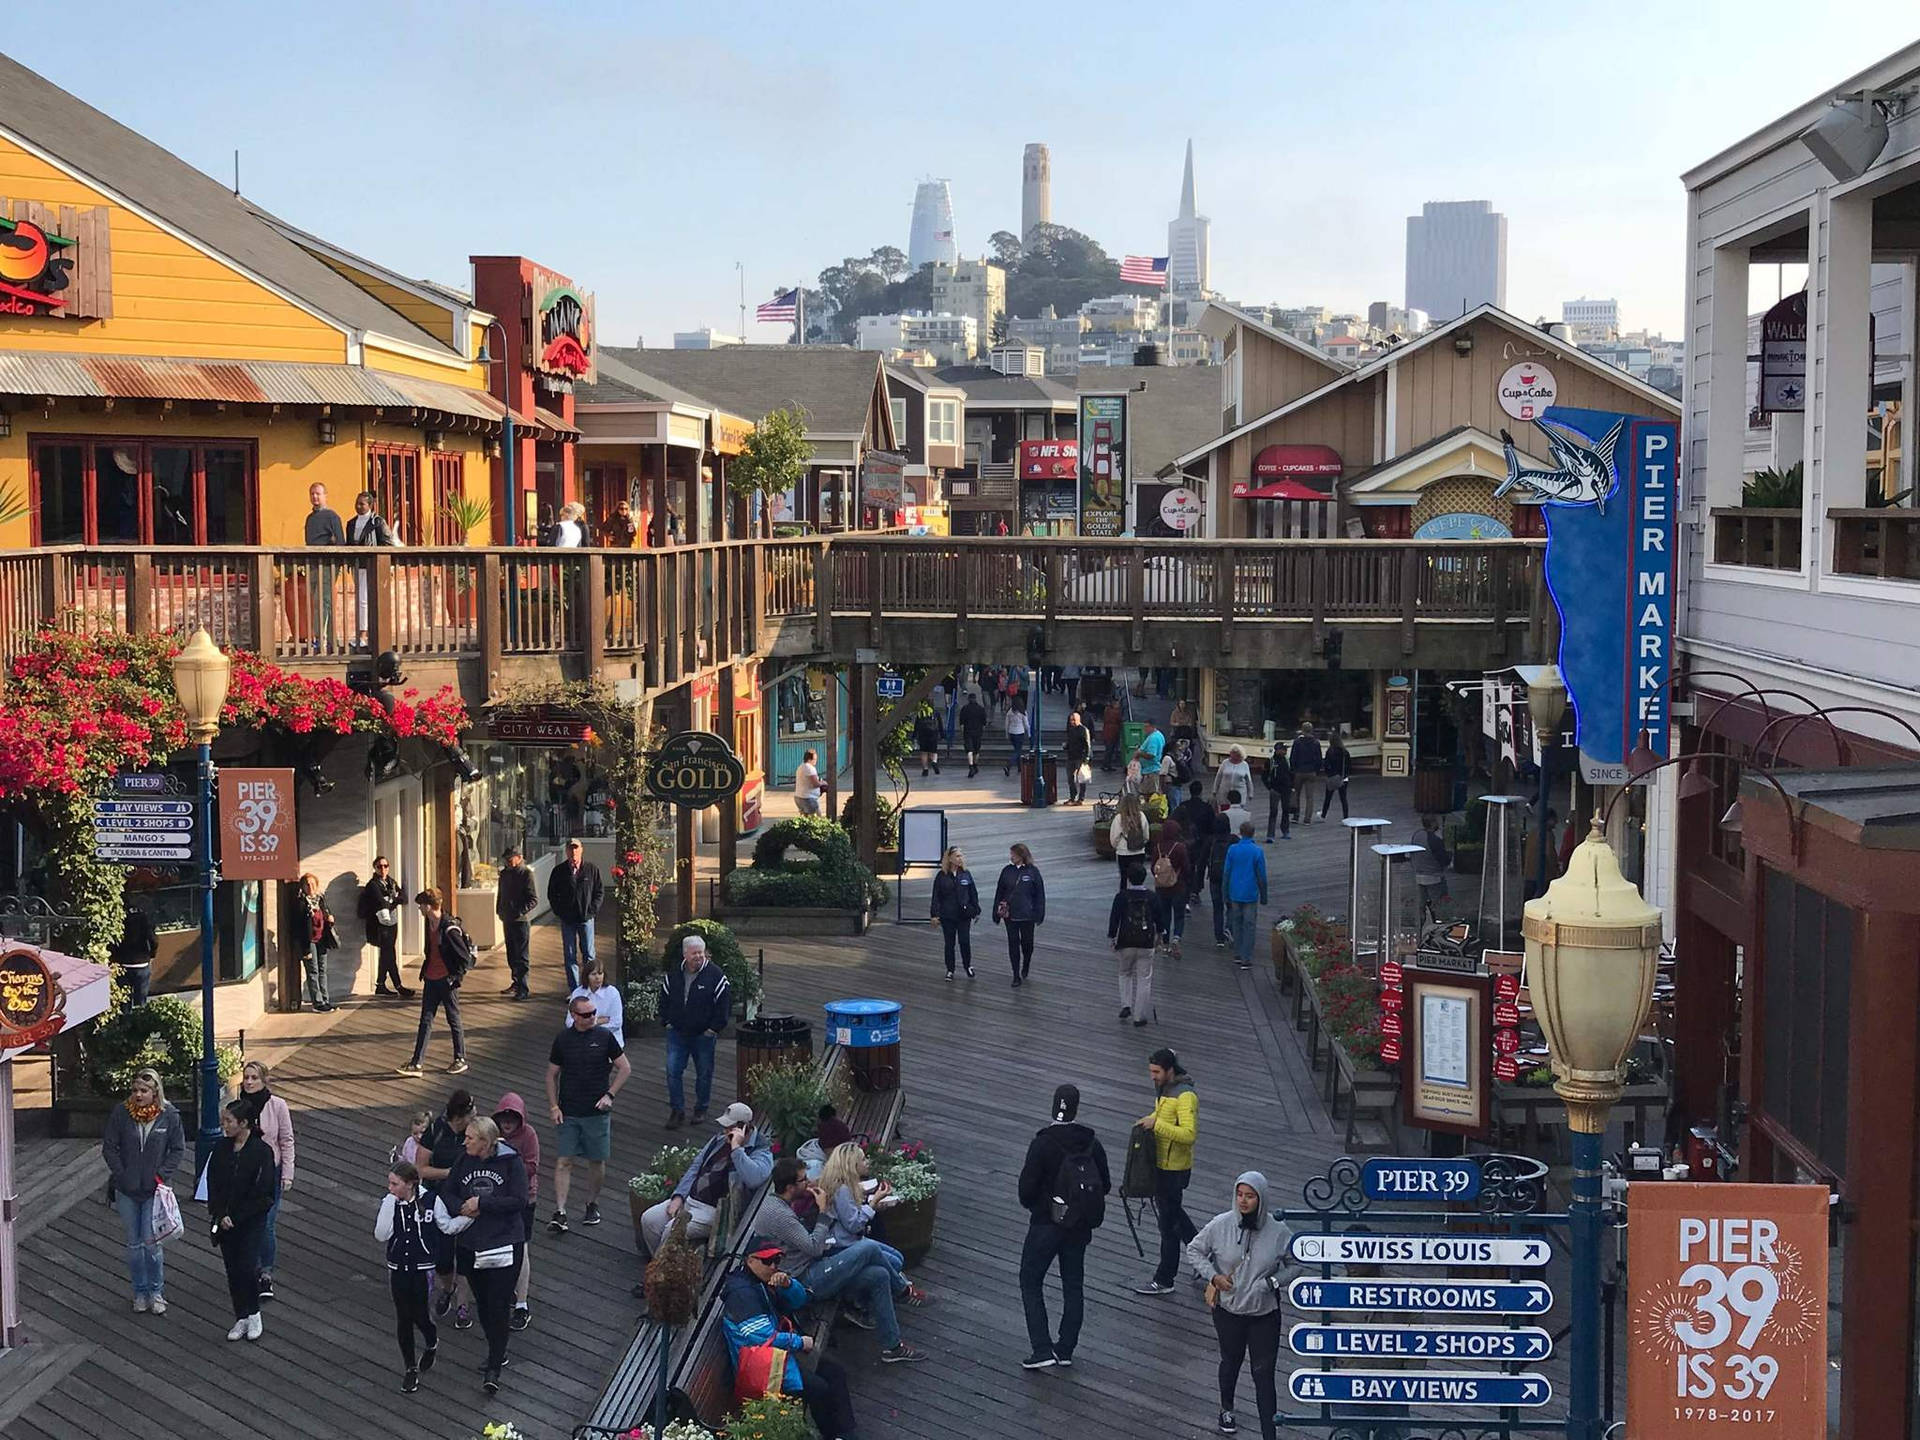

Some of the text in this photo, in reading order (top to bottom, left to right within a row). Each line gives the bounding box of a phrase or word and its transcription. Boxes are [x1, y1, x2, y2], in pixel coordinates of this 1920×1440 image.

[0, 296, 34, 315] xico
[1502, 388, 1521, 400] Cup
[1528, 387, 1553, 398] Cake
[1040, 446, 1078, 457] NFL Sh
[1642, 435, 1668, 552] PIER
[502, 725, 570, 735] CITY WEAR
[662, 755, 727, 770] San Francisco
[656, 767, 732, 789] GOLD
[1590, 768, 1622, 779] SINCE
[124, 778, 160, 788] PIER 39
[238, 782, 277, 800] PIER
[114, 804, 164, 812] BAY VIEWS
[238, 800, 278, 833] 39
[106, 818, 174, 827] LEVEL 2 SHOPS
[123, 834, 165, 842] MANGO'S
[240, 834, 279, 852] IS 39
[1418, 954, 1473, 970] PIER MARKET
[0, 970, 45, 985] Charms
[462, 1169, 505, 1186] SAN FRANCISCO
[1377, 1169, 1470, 1192] PIER 39
[1680, 1218, 1779, 1264] PIER
[1340, 1240, 1492, 1261] SWISS LOUIS
[1350, 1287, 1497, 1307] RESTROOMS
[1674, 1264, 1780, 1350] 39
[1336, 1333, 1516, 1355] LEVEL 2 SHOPS
[1677, 1354, 1780, 1401] IS 39
[1351, 1379, 1478, 1399] BAY VIEWS
